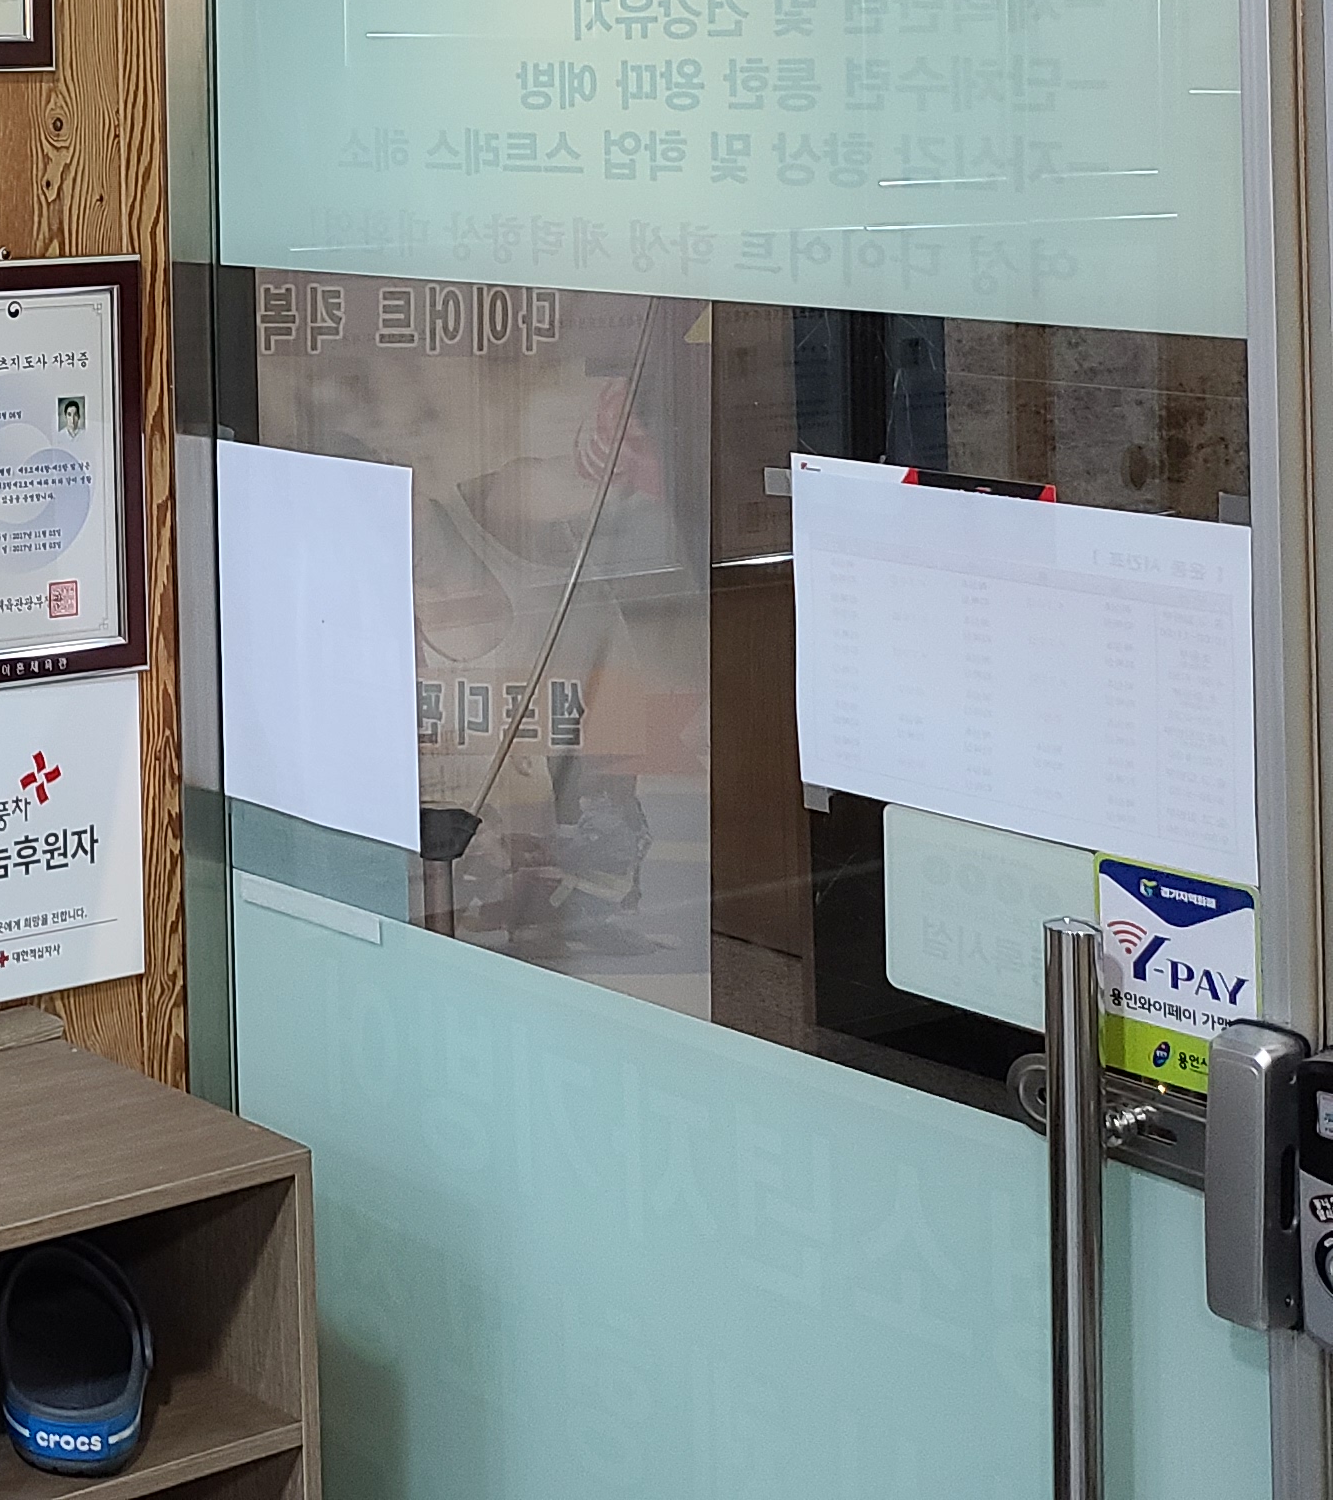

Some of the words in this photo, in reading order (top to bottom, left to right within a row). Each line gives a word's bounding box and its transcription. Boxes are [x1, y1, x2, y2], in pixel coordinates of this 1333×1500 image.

[52, 351, 89, 370] 자격증
[23, 916, 48, 932] 희망을
[51, 909, 88, 926] 전합니다.
[12, 945, 61, 965] 대한적십자사
[1132, 933, 1249, 1006] Y-PAY
[1110, 987, 1197, 1027] 용인와이페이
[36, 1428, 102, 1452] crocs
